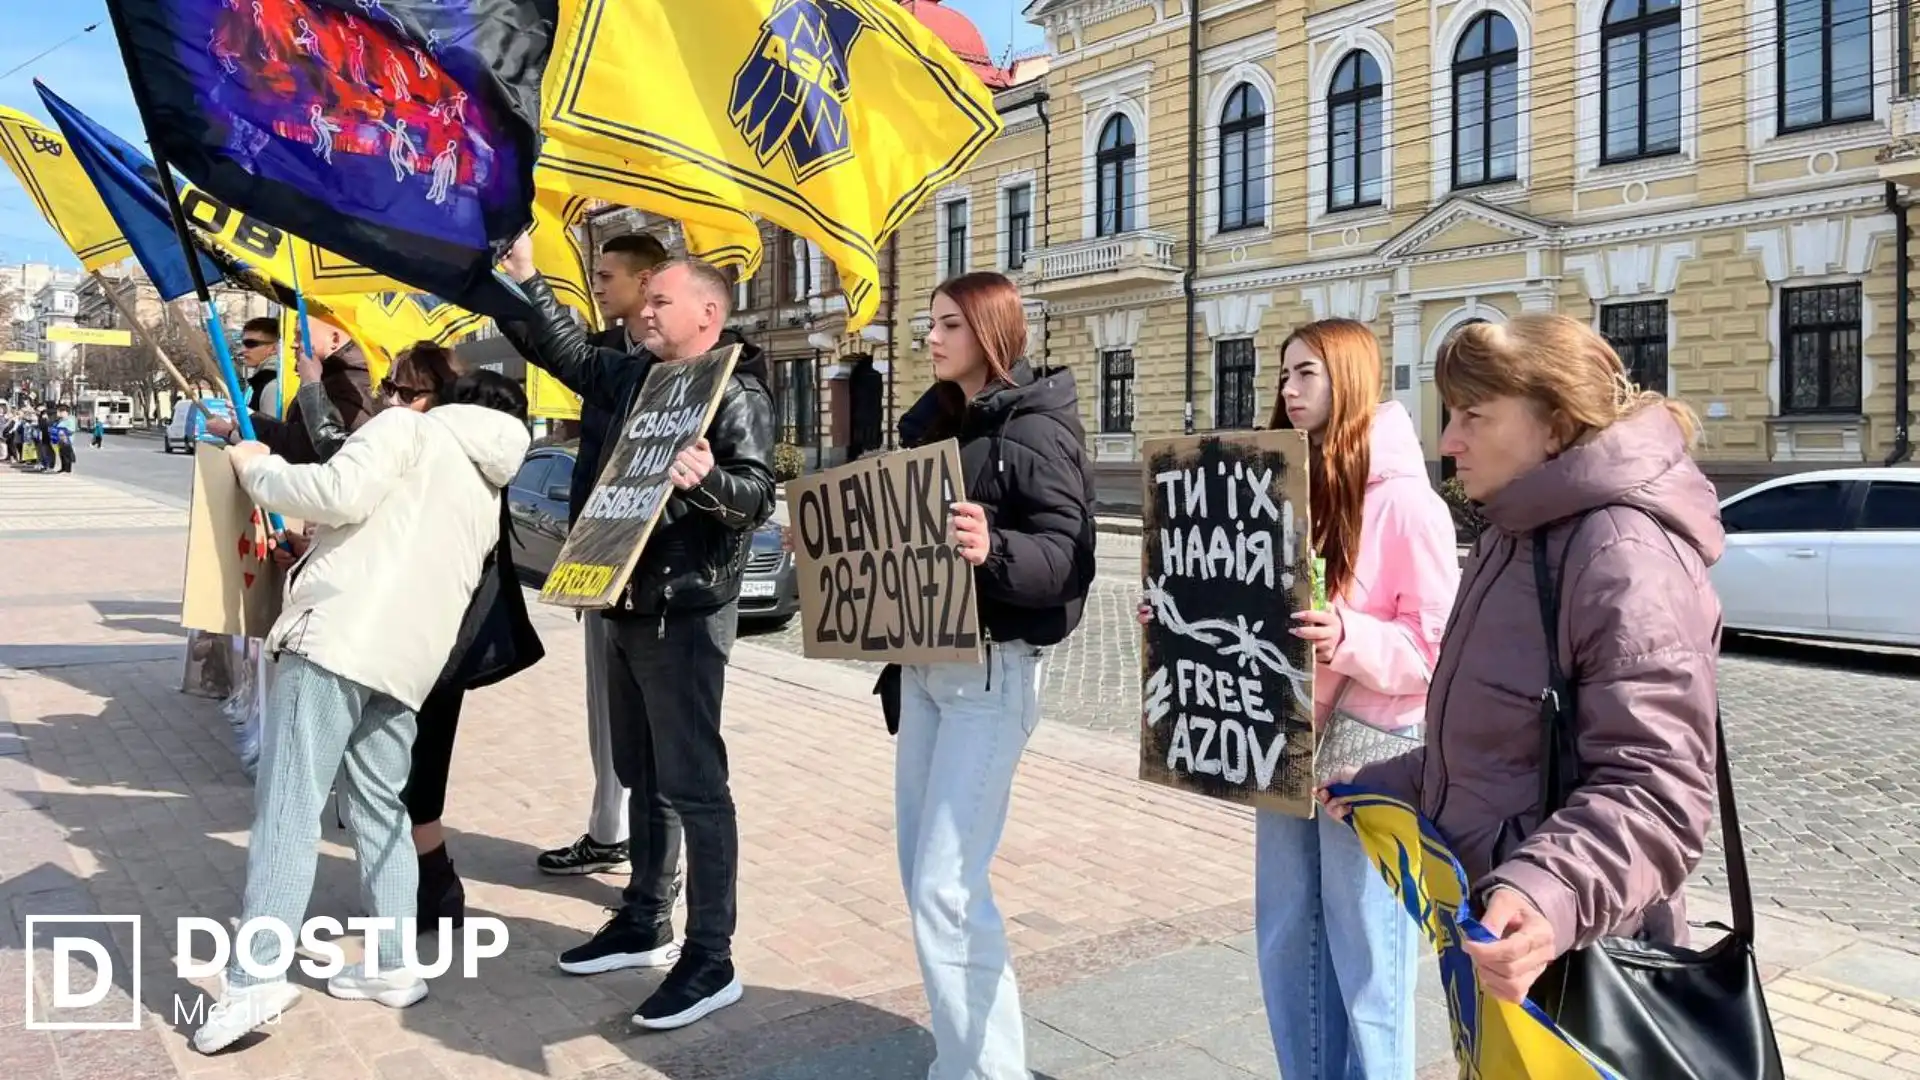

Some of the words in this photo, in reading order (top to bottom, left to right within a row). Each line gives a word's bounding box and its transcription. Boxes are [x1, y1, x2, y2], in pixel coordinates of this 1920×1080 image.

[665, 366, 695, 408] ЇХ
[1155, 465, 1207, 520] ТИ
[1218, 461, 1279, 521] ЇХ
[1175, 658, 1275, 724] FREE
[1166, 711, 1287, 792] AZOV
